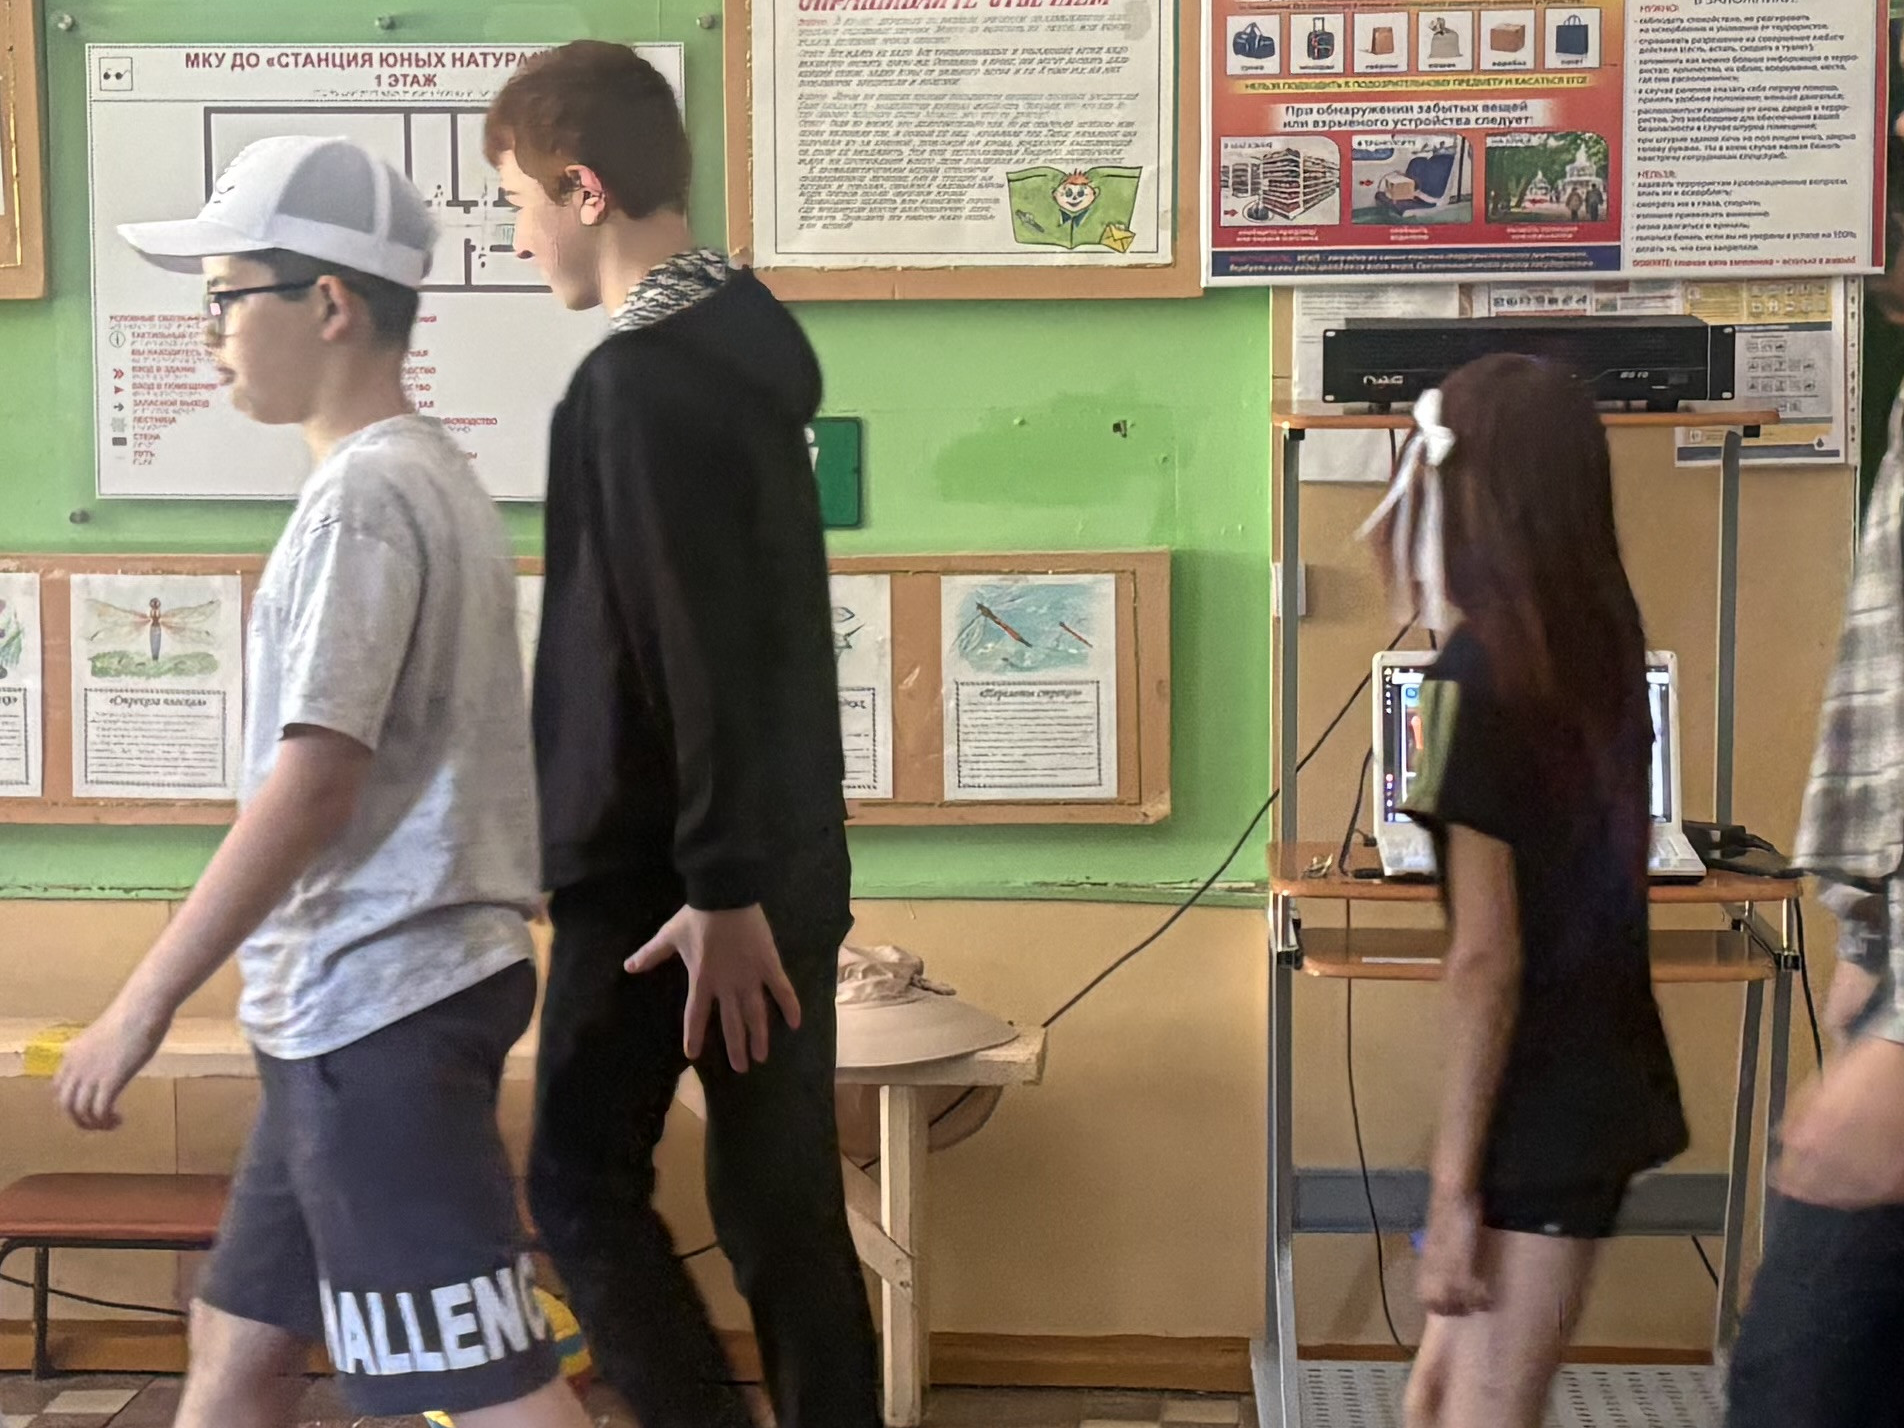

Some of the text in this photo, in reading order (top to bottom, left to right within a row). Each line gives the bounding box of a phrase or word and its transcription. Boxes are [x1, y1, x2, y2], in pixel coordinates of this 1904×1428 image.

[185, 52, 226, 69] МКУ
[230, 53, 260, 72] ДО
[266, 52, 374, 71] «СТАНЦИЯ
[379, 52, 445, 68] ЮНЫХ
[375, 73, 437, 87] 1 ЭТАЖ
[1285, 106, 1313, 118] При
[1317, 104, 1414, 119] обнаружении
[1417, 102, 1478, 114] забытых
[1283, 119, 1309, 130] или
[1392, 115, 1477, 129] устройства
